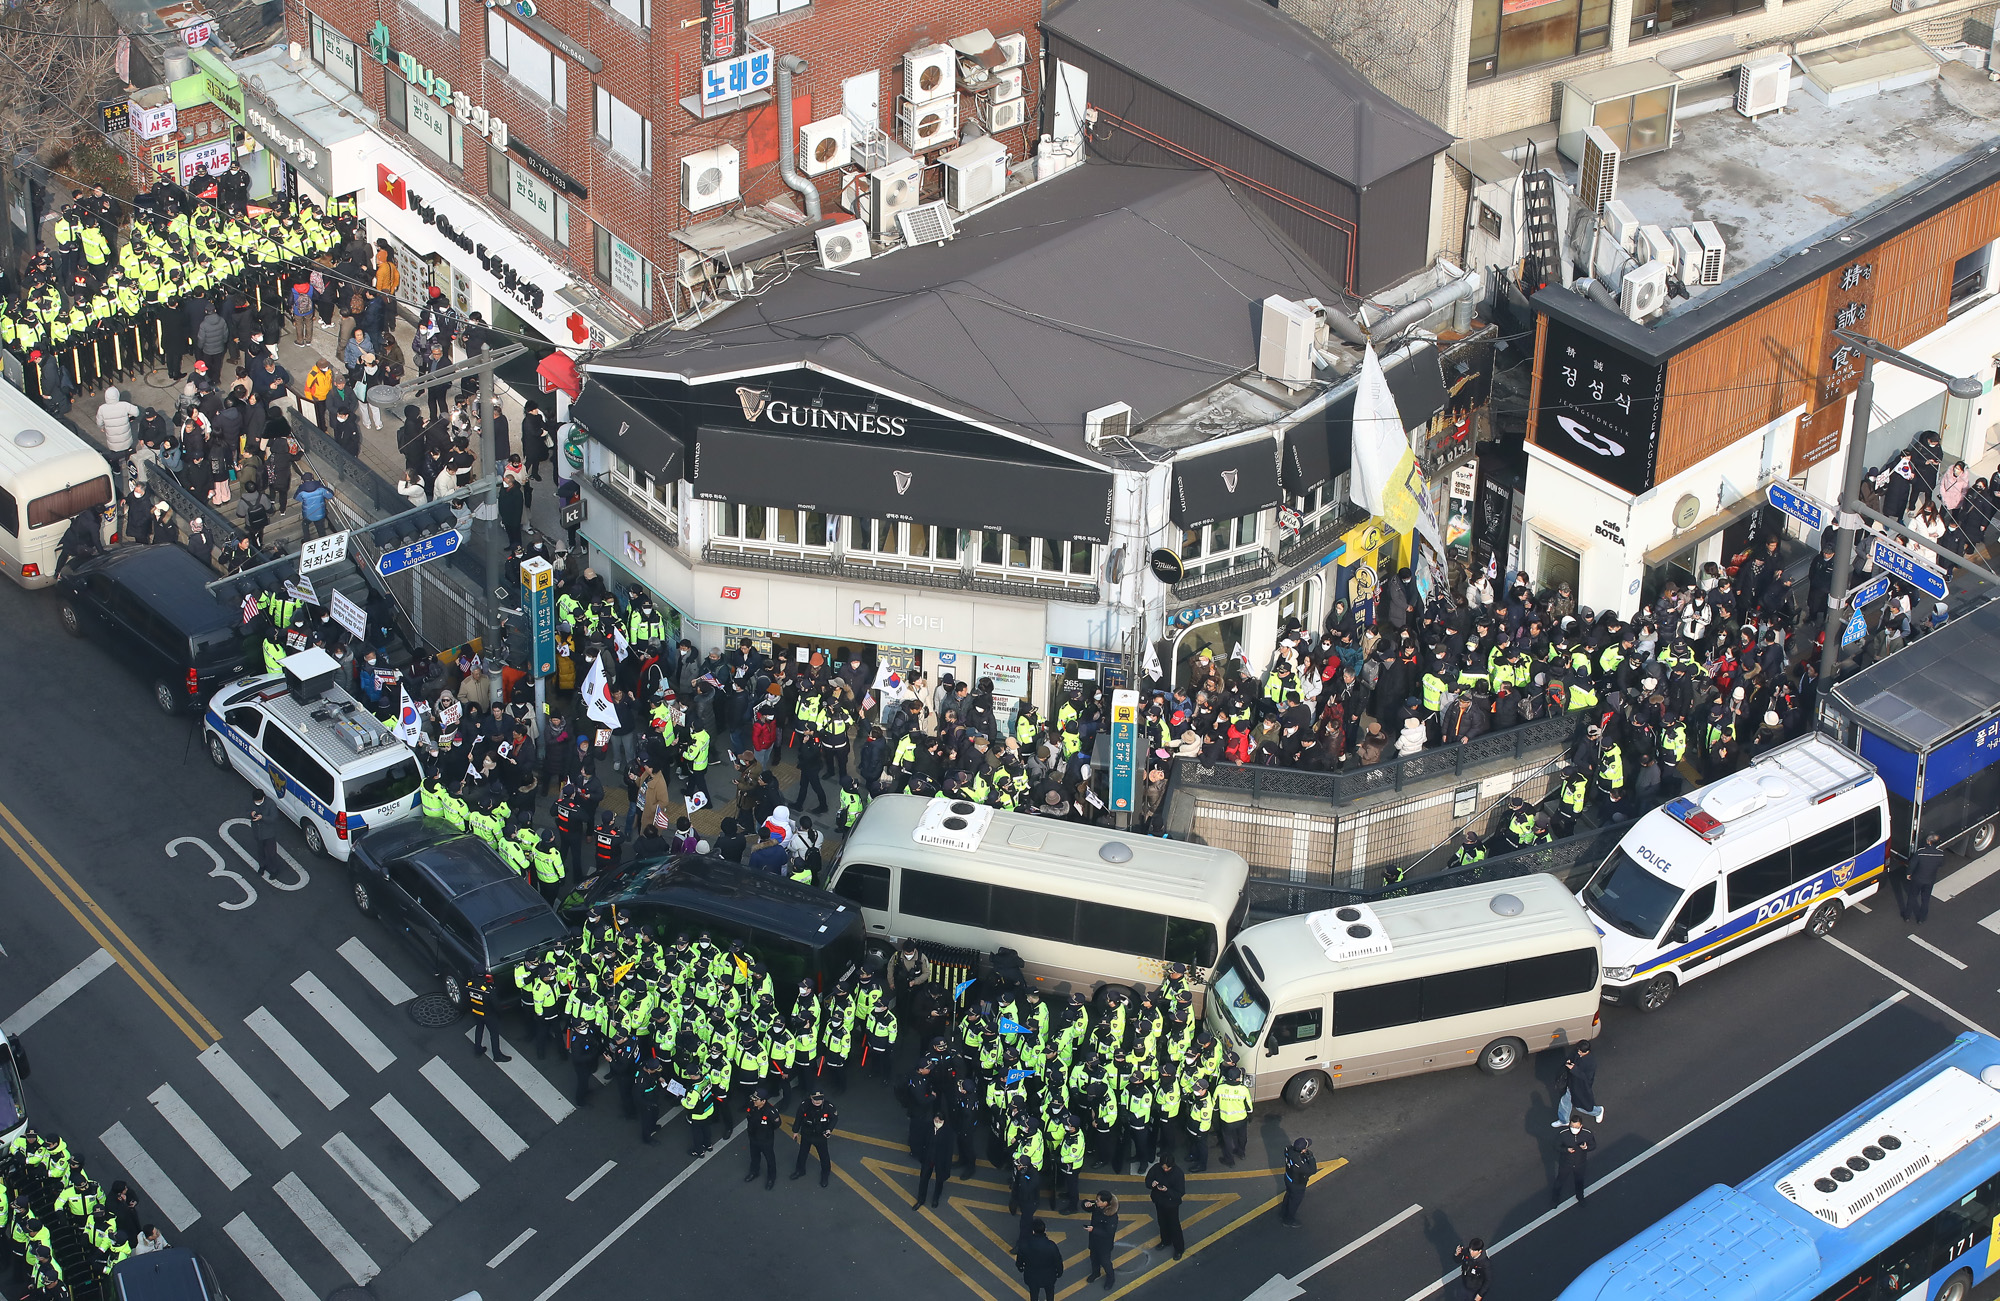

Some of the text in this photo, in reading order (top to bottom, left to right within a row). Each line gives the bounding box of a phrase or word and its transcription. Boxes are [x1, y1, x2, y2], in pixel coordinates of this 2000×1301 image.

[187, 27, 209, 45] 타로
[326, 40, 353, 69] 한의원
[708, 54, 769, 99] 노래방
[413, 95, 430, 112] 대나무
[150, 117, 172, 132] 사주
[414, 105, 442, 135] 한의원
[528, 156, 566, 190] 02-743-7533
[516, 181, 547, 213] 한의원
[1561, 365, 1631, 415] 정성식
[766, 400, 906, 437] GUINNESS
[1177, 475, 1187, 513] GUINNESS
[566, 509, 579, 524] kt
[1104, 488, 1113, 526] GUINNESS
[1783, 503, 1818, 528] Bukchon-ro
[1792, 498, 1819, 519] 북촌로
[1594, 525, 1626, 548] BOTEA
[1602, 518, 1621, 533] cafe
[403, 541, 434, 559] 율곡로
[445, 538, 456, 547] 65
[624, 530, 646, 568] kt
[302, 548, 344, 569] 직좌신호
[382, 559, 392, 569] 61
[402, 551, 437, 567] Yulgok-ro
[1154, 559, 1178, 571] Miller
[1876, 555, 1913, 581] Samil-daero
[1878, 546, 1914, 573] 삼일대로
[541, 590, 547, 599] 2
[724, 589, 737, 598] 5G
[1200, 588, 1273, 621] 신한은행
[853, 600, 887, 629] kt
[896, 612, 944, 633] 케이티
[983, 662, 1021, 673] K-AI 시대
[444, 704, 458, 716] STOP
[1121, 724, 1128, 733] 3
[1115, 742, 1125, 761] 안국
[377, 801, 400, 814] POLICE
[165, 818, 310, 911] 30
[1637, 845, 1672, 874] POLICE
[1755, 880, 1823, 924] POLICE
[1949, 1232, 1974, 1261] 171
